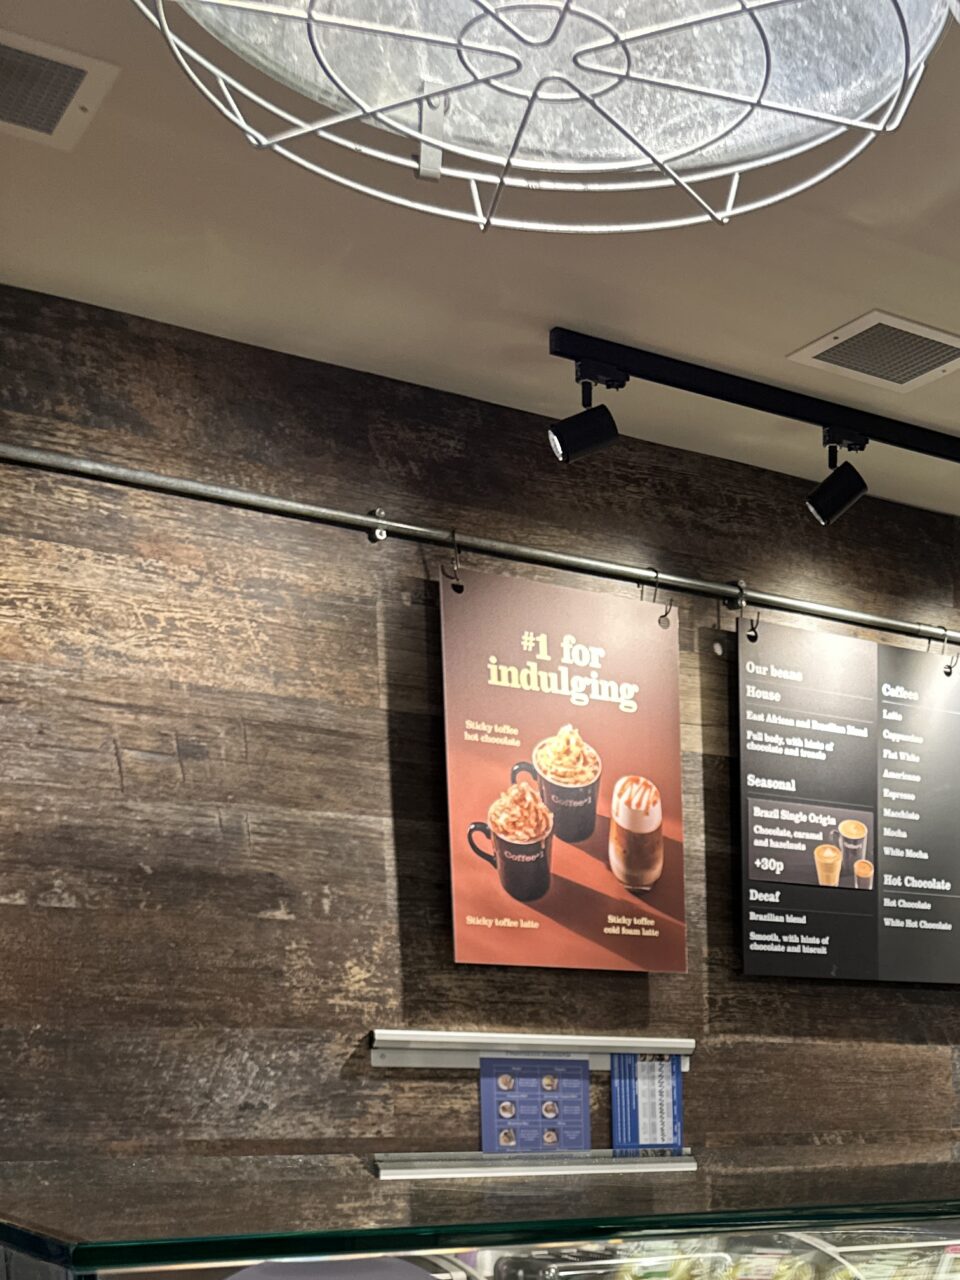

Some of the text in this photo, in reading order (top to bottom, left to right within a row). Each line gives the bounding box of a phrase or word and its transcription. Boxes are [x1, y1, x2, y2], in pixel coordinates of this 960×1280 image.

[521, 631, 606, 669] #1 for
[746, 661, 768, 675] Our
[487, 656, 639, 712] indulging
[746, 685, 781, 702] House
[465, 720, 519, 735] Sticky toffee
[464, 731, 520, 747] hot chocolate
[746, 773, 796, 792] Seasonal
[753, 807, 836, 826] Brazil Single Origin
[754, 858, 784, 874] +30p
[883, 874, 951, 890] Hot Chocolate
[749, 889, 781, 902] Decaf
[466, 915, 540, 929] Sticky toffee latte
[607, 914, 655, 927] Sticky toffee
[749, 912, 784, 922] Brazilian
[604, 926, 659, 937] cold foam latte
